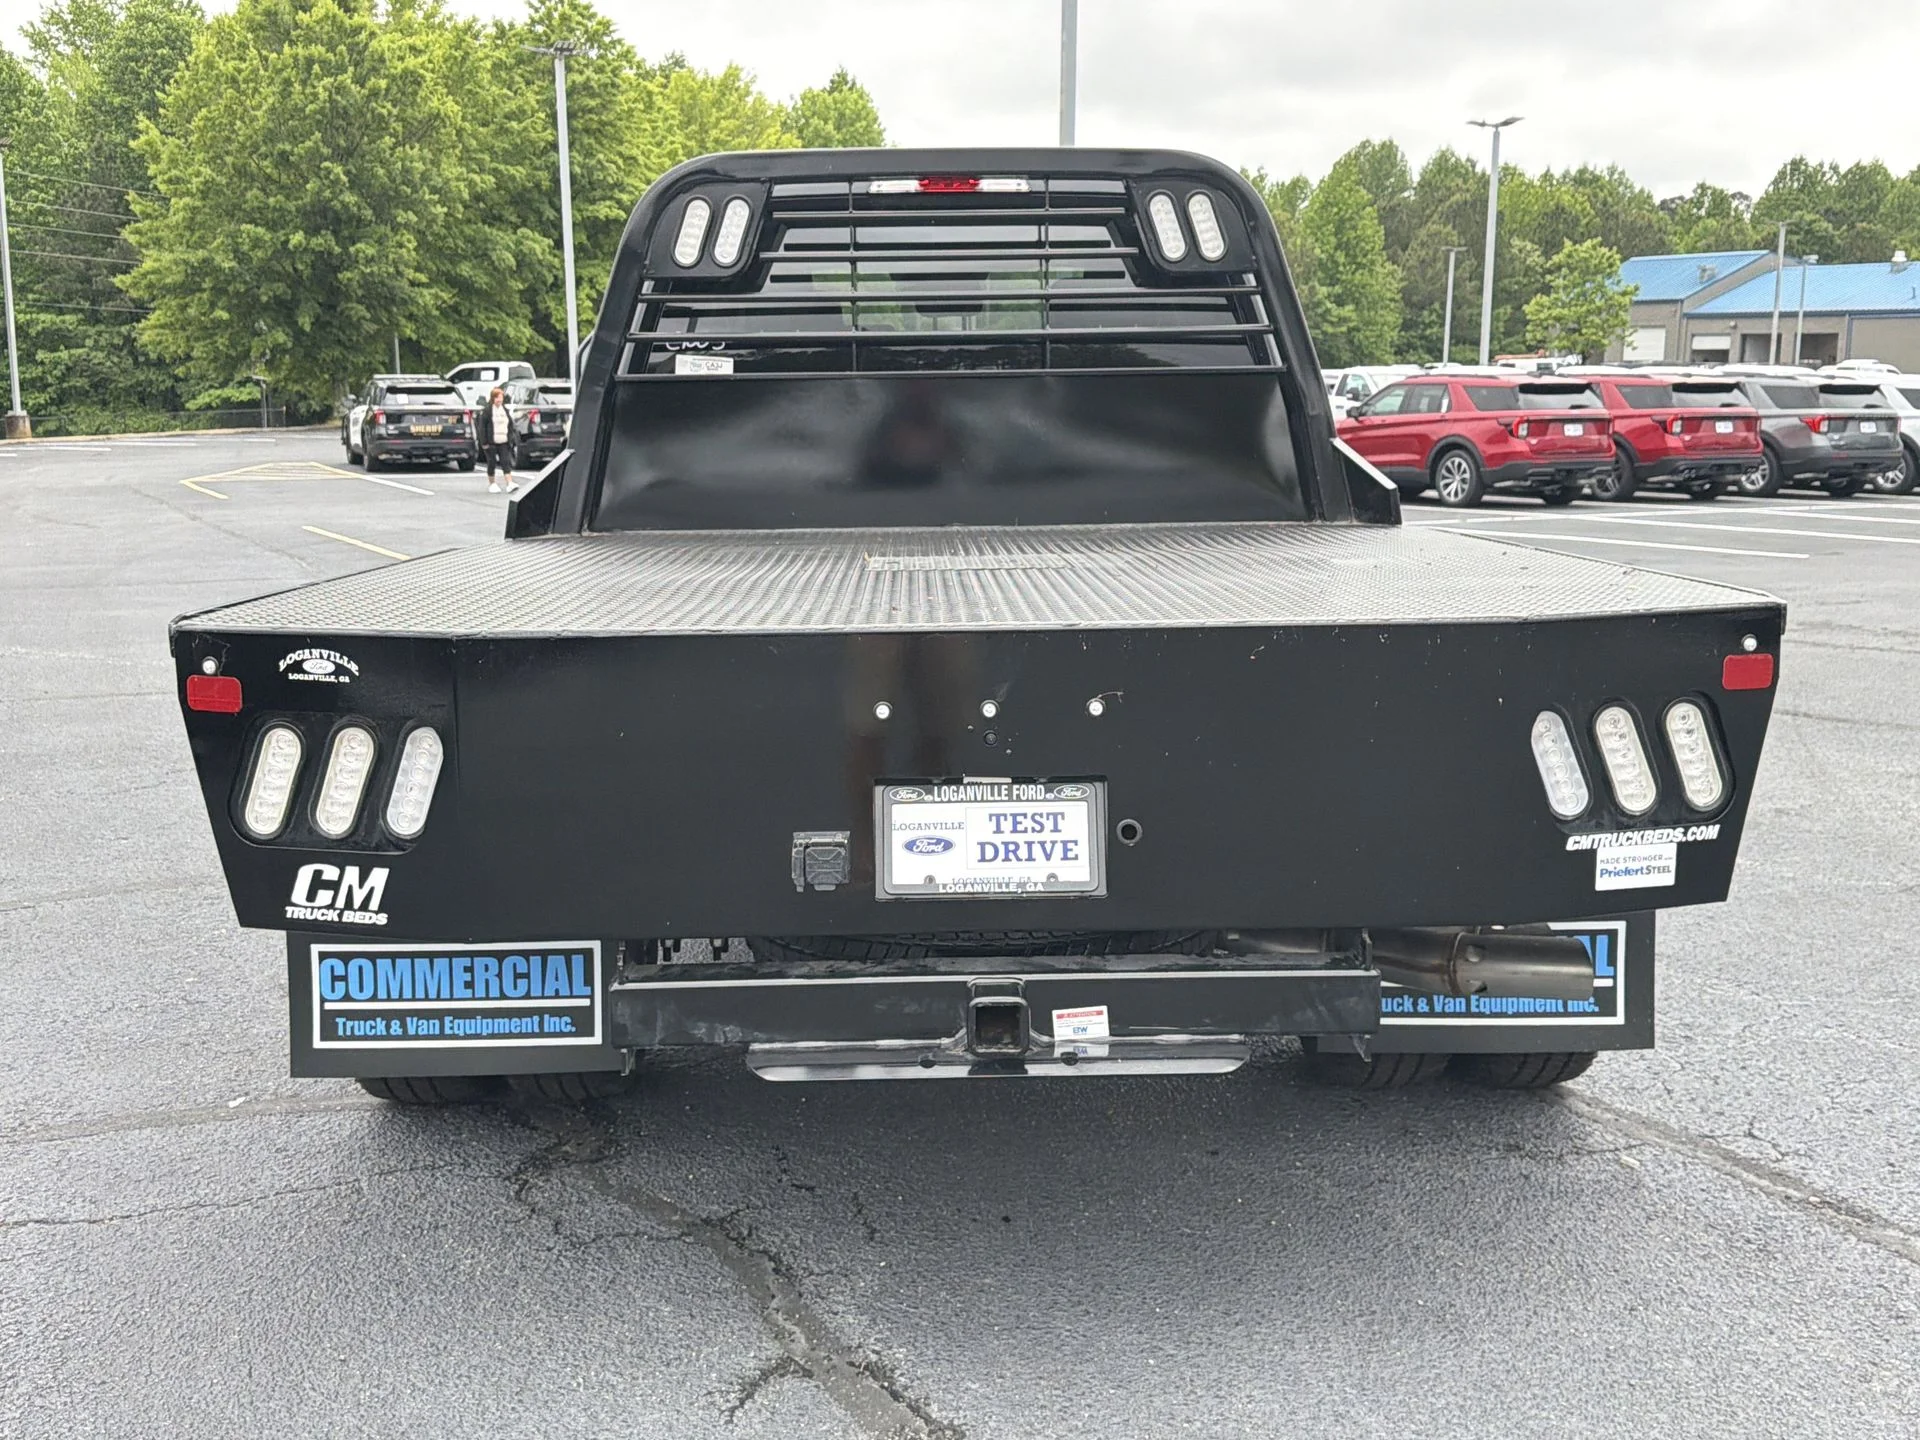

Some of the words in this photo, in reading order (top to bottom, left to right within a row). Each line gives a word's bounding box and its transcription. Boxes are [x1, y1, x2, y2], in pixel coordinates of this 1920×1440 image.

[279, 648, 359, 676] LOGANVILLE
[288, 673, 338, 683] LOGANVILLE,
[933, 785, 1009, 802] LOGANVILLE
[1012, 784, 1046, 800] FORD
[892, 821, 965, 831] LOGANVILLE
[988, 812, 1065, 835] TEST
[912, 839, 945, 853] Ford
[1565, 824, 1720, 851] CMTRUCKBEDS.COM
[976, 840, 1079, 863] DRIVE
[291, 863, 390, 911] CM
[938, 883, 1023, 894] LOGANVILLE,
[1025, 882, 1045, 892] GA
[285, 906, 340, 922] TRUCK
[341, 910, 389, 925] BEDS
[319, 955, 591, 1000] COMMERCIAL
[1381, 995, 1414, 1012] uck
[1417, 998, 1429, 1012] &
[1433, 994, 1466, 1013] Van
[1470, 994, 1564, 1014] Equipment
[335, 1017, 386, 1036] Truck
[389, 1019, 403, 1034] &
[406, 1016, 440, 1035] Van
[444, 1015, 540, 1036] Equipment
[543, 1014, 577, 1032] Inc.
